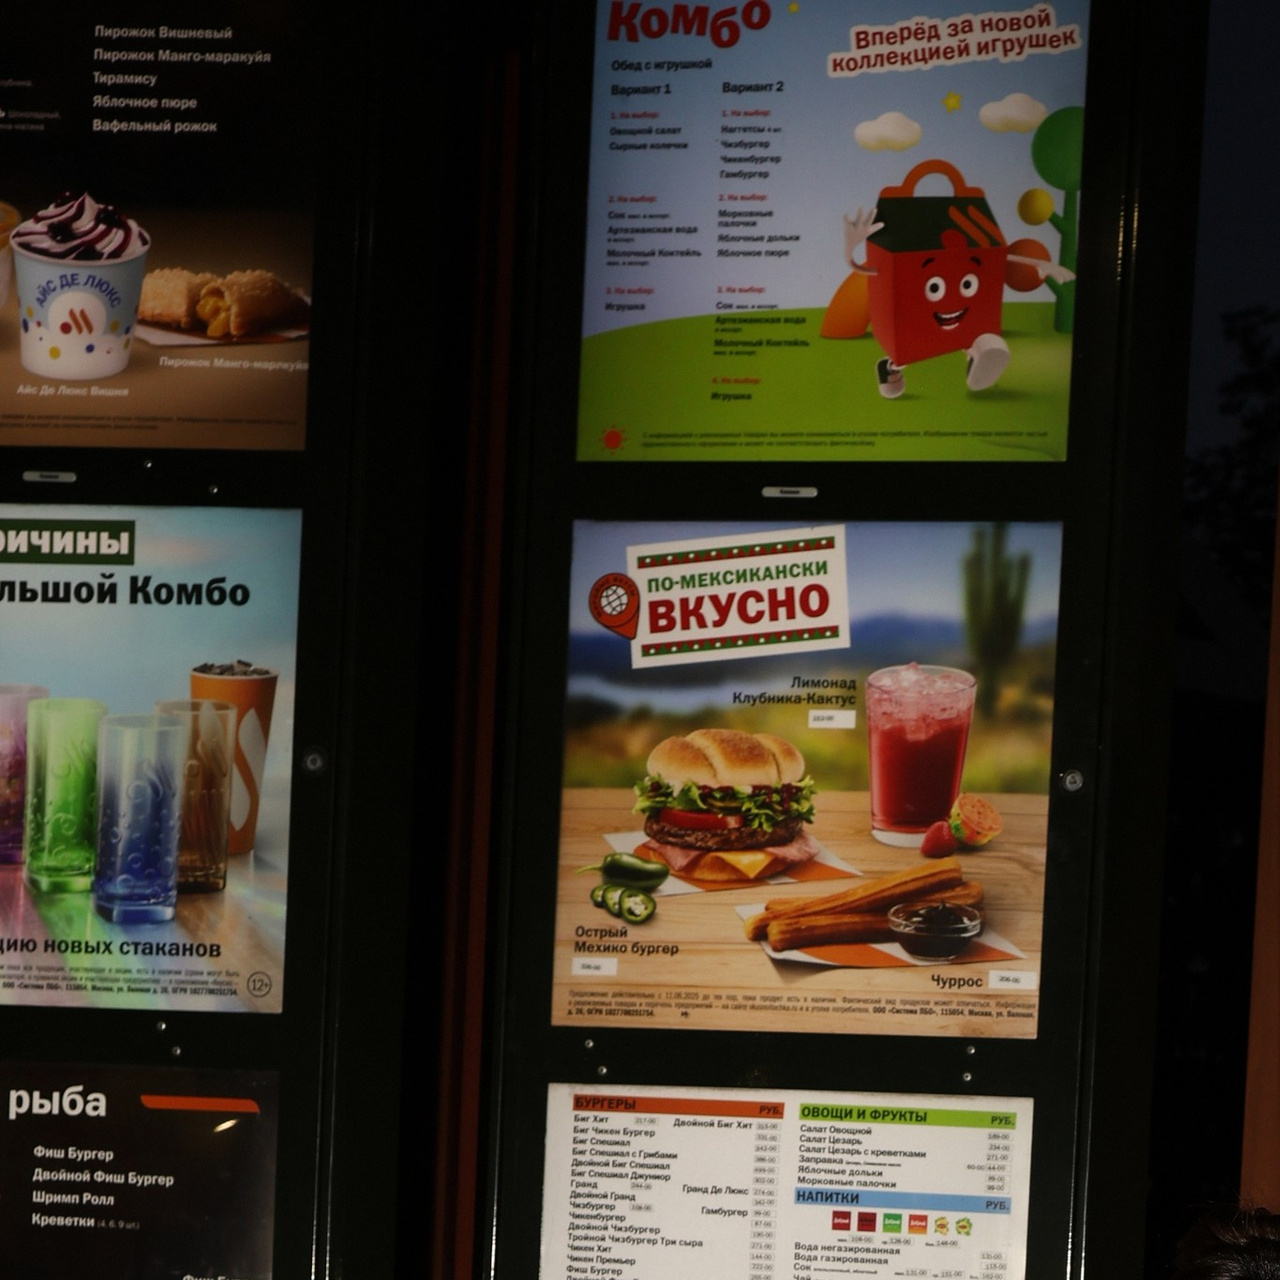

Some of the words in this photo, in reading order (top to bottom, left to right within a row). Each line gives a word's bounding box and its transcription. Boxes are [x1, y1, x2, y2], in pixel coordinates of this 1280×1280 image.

[606, 0, 771, 49] Комбо
[855, 22, 940, 50] Вперёд
[947, 18, 973, 37] за
[980, 8, 1051, 34] новой
[95, 25, 156, 39] Пирожок
[159, 26, 233, 40] Вишневый
[94, 49, 155, 63] Пирожок
[158, 49, 272, 65] Манго-маракуйя
[831, 39, 970, 73] коллекцией
[976, 28, 1077, 57] игрушек
[611, 59, 642, 72] Обед
[645, 62, 650, 70] с
[654, 58, 713, 72] игрушкой
[92, 71, 158, 87] Тирамису
[611, 84, 661, 96] Вариант
[664, 83, 671, 94] 1
[722, 82, 772, 94] Вариант
[776, 81, 784, 92] 2
[92, 95, 159, 108] Яблочное
[161, 98, 198, 111] пюре
[92, 118, 172, 133] Вафельный
[174, 121, 218, 134] рожок
[59, 273, 80, 289] ДЕ
[0, 529, 130, 555] ичины
[647, 559, 829, 593] ПО-МЕКСИКАНСКИ
[129, 575, 250, 606] Комбо
[648, 583, 830, 634] ВКУСНО
[791, 675, 857, 691] Лимонад
[732, 691, 857, 708] Клубника-Кактус
[575, 925, 628, 940] Острый
[43, 939, 113, 955] новых
[119, 940, 222, 958] стаканов
[574, 941, 627, 954] Мехико
[631, 941, 679, 956] бургер
[251, 978, 270, 991] 12+
[931, 974, 983, 989] Чуррос
[8, 1084, 107, 1120] рыба
[575, 1097, 636, 1110] БУРГЕРЫ
[573, 1114, 591, 1124] Биг
[592, 1114, 609, 1124] Хит
[801, 1106, 853, 1121] ОВОЩИ
[856, 1108, 866, 1120] И
[869, 1108, 927, 1123] ФРУКТЫ
[991, 1115, 1015, 1126] РУБ.
[673, 1118, 716, 1128] Двойной
[717, 1119, 734, 1129] Биг
[736, 1120, 753, 1130] Хит
[800, 1124, 827, 1134] Салат
[829, 1126, 872, 1137] Овощной
[799, 1134, 826, 1144] Салат
[828, 1135, 863, 1146] Цезарь
[33, 1145, 65, 1159] Фиш
[68, 1146, 114, 1162] Бургер
[798, 1154, 844, 1166] Заправка
[32, 1167, 90, 1182] Двойной
[93, 1170, 125, 1184] Фиш
[128, 1171, 174, 1187] Бургер
[798, 1166, 847, 1176] Яблочные
[848, 1168, 883, 1179] дольки
[570, 1180, 598, 1190] Гранд
[797, 1176, 854, 1187] Морковные
[856, 1179, 897, 1189] палочки
[32, 1190, 79, 1205] Шримп
[82, 1193, 115, 1206] Ролл
[797, 1190, 859, 1205] НАПИТКИ
[701, 1207, 748, 1218] Гамбургер
[31, 1213, 94, 1228] Креветки
[794, 1241, 819, 1253] Вода
[820, 1244, 901, 1256] негазированная
[794, 1252, 818, 1263] Вода
[820, 1254, 889, 1266] газированная
[793, 1262, 812, 1272] Сок
